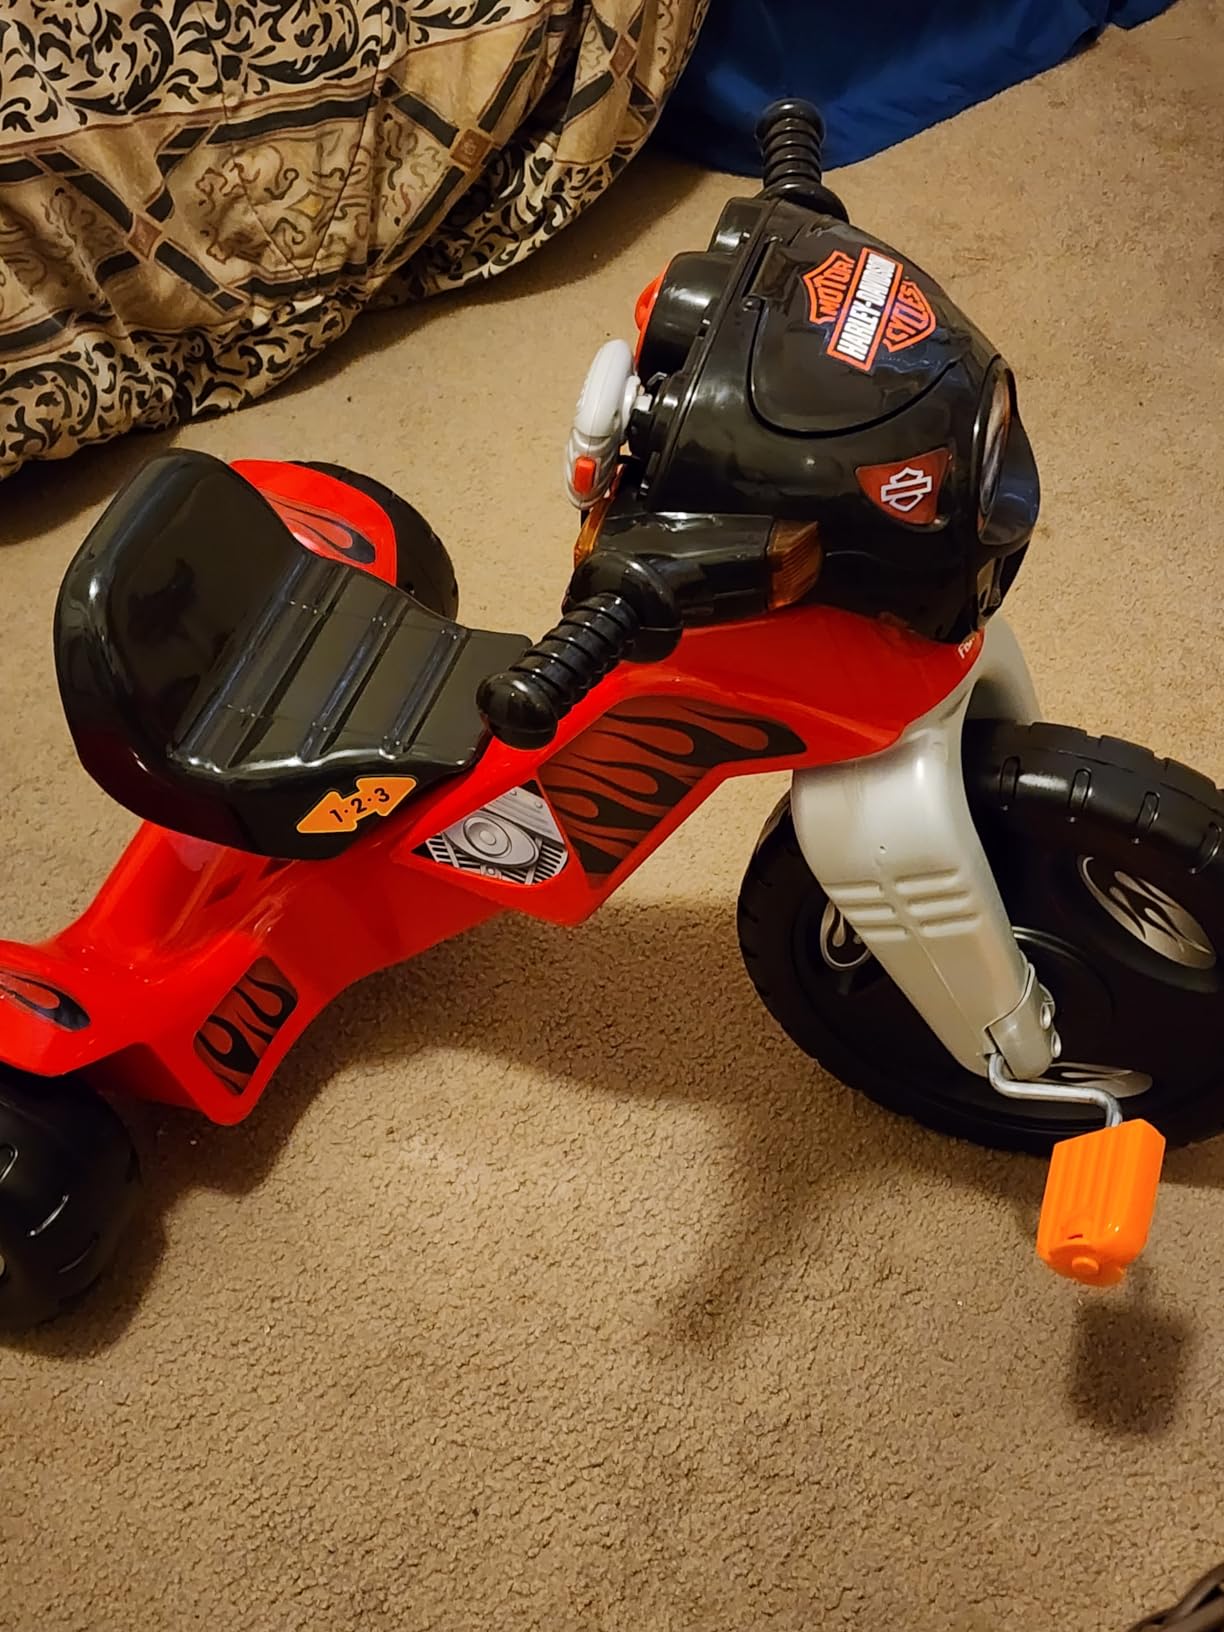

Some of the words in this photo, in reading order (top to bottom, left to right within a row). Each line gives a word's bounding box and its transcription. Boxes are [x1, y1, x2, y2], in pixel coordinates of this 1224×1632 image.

[812, 260, 855, 316] MOTOR
[836, 252, 897, 361] HARLEY-DAVIDSON
[886, 284, 929, 342] CYCLES
